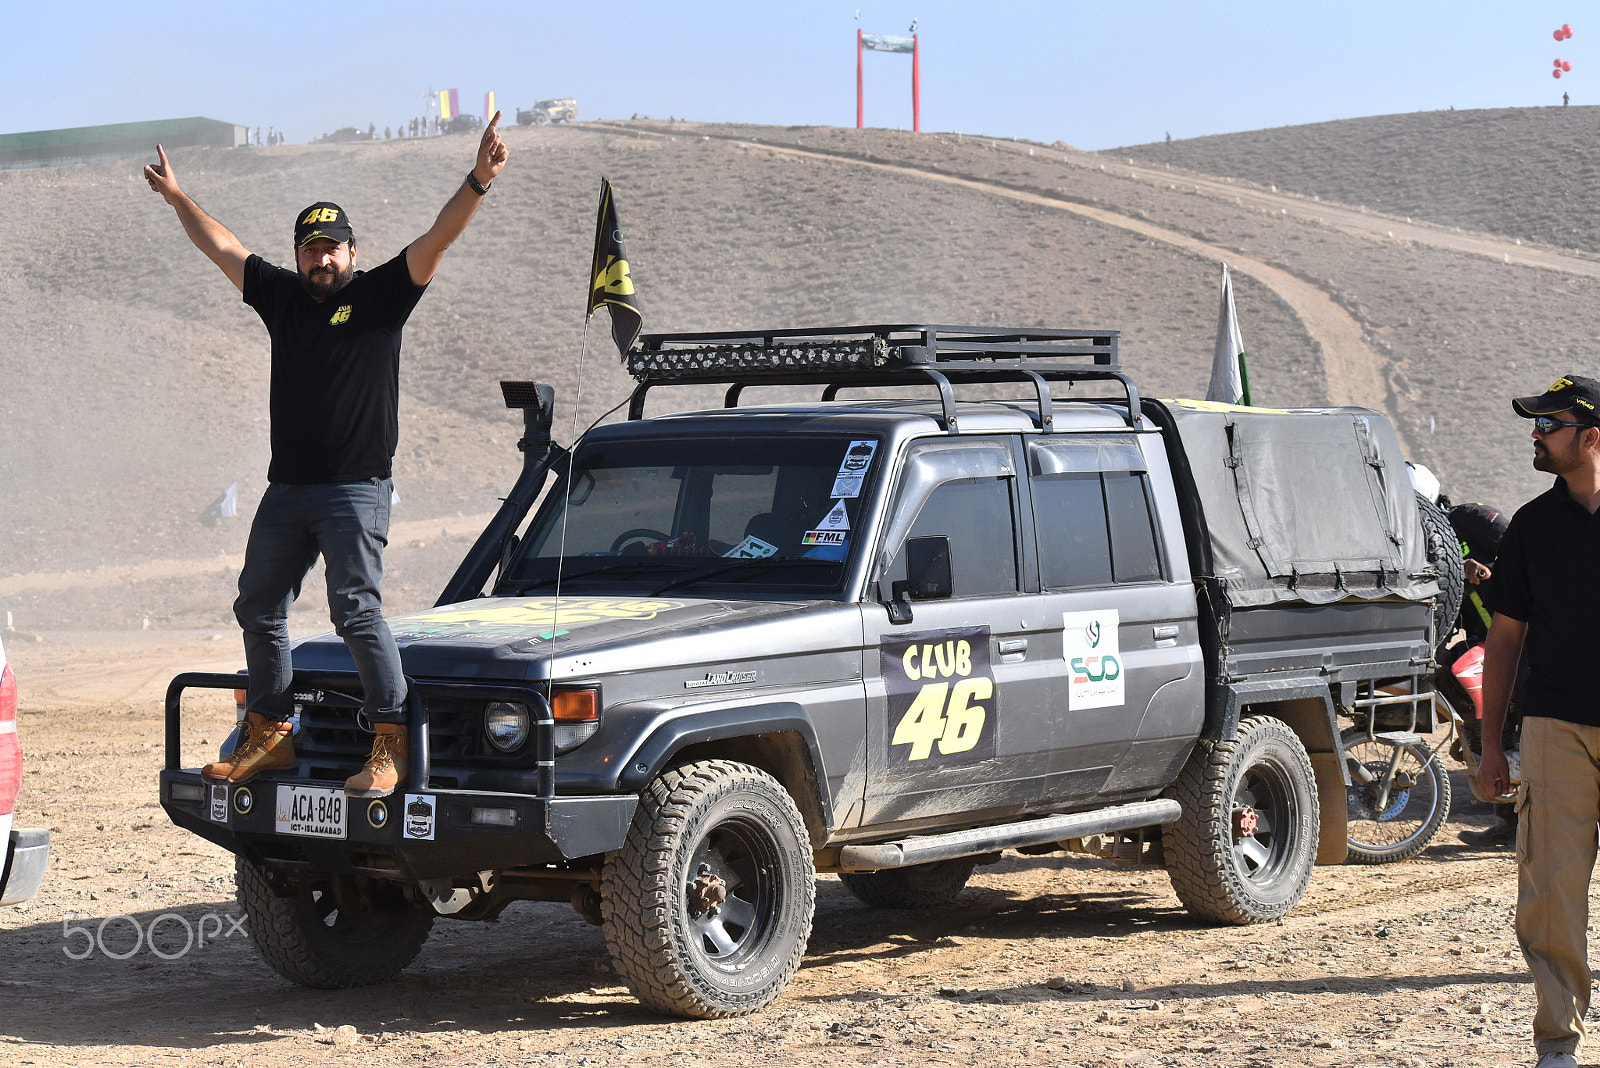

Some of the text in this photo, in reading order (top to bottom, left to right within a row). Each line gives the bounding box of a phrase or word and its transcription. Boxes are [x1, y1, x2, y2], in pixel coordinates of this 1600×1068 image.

[302, 208, 339, 224] 46
[330, 310, 352, 323] 46
[816, 533, 843, 541] FML
[902, 639, 973, 681] CLUB
[891, 676, 994, 761] 46
[724, 799, 782, 829] COOPER
